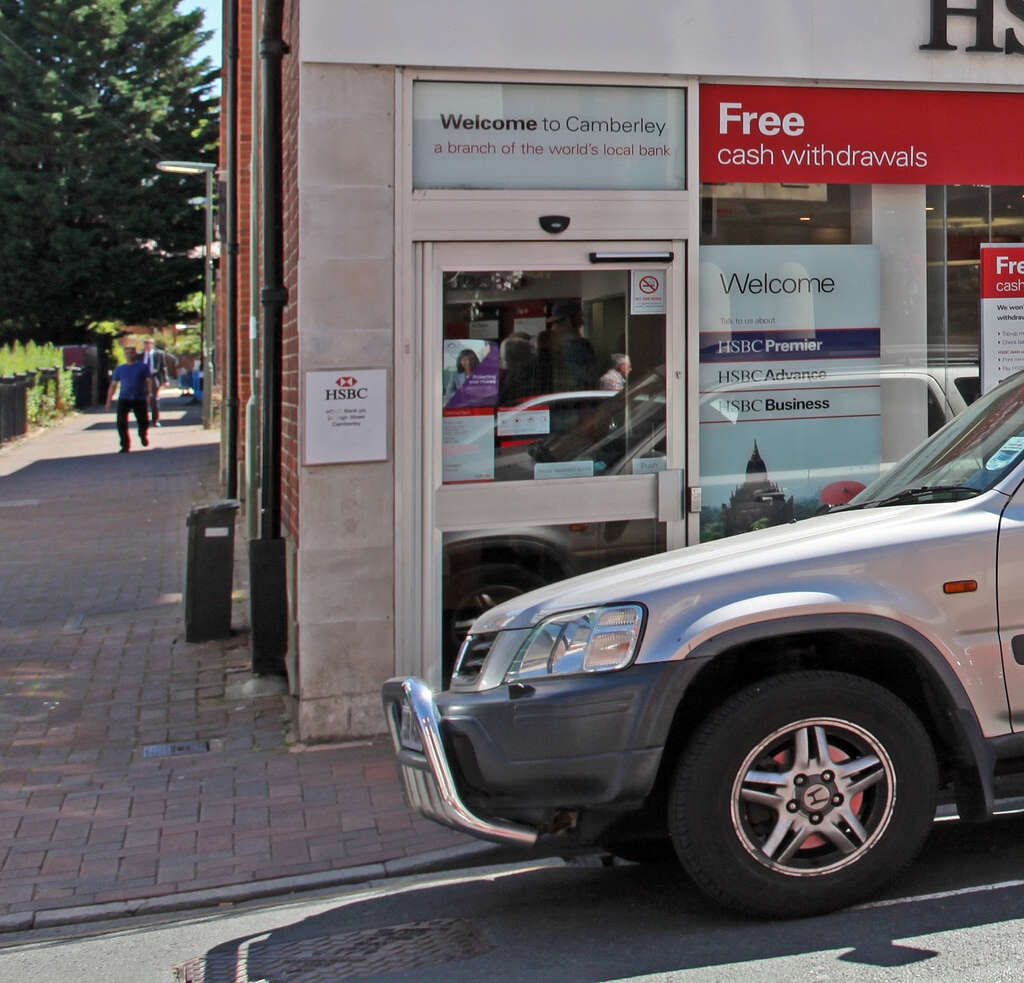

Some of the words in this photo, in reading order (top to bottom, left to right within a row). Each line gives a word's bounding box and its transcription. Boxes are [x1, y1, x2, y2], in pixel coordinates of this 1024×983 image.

[440, 113, 538, 132] Welcome
[542, 117, 561, 132] to
[566, 115, 667, 137] Camberley
[719, 102, 805, 137] Free
[433, 143, 443, 154] a
[448, 141, 497, 154] branch
[501, 141, 516, 154] of
[521, 142, 544, 155] the
[548, 143, 599, 156] world's
[603, 143, 634, 156] local
[639, 143, 670, 157] bank
[717, 143, 775, 165] cash
[781, 143, 928, 168] withdrawals
[720, 272, 835, 295] Welcome
[720, 317, 734, 325] Talk
[718, 340, 764, 354] HSBC
[765, 338, 823, 352] Premier
[718, 369, 763, 384] HSBC
[764, 369, 827, 382] Advance
[325, 388, 368, 401] HSBC
[718, 399, 764, 413] HSBC
[765, 398, 830, 411] Business
[641, 461, 659, 469] Push
